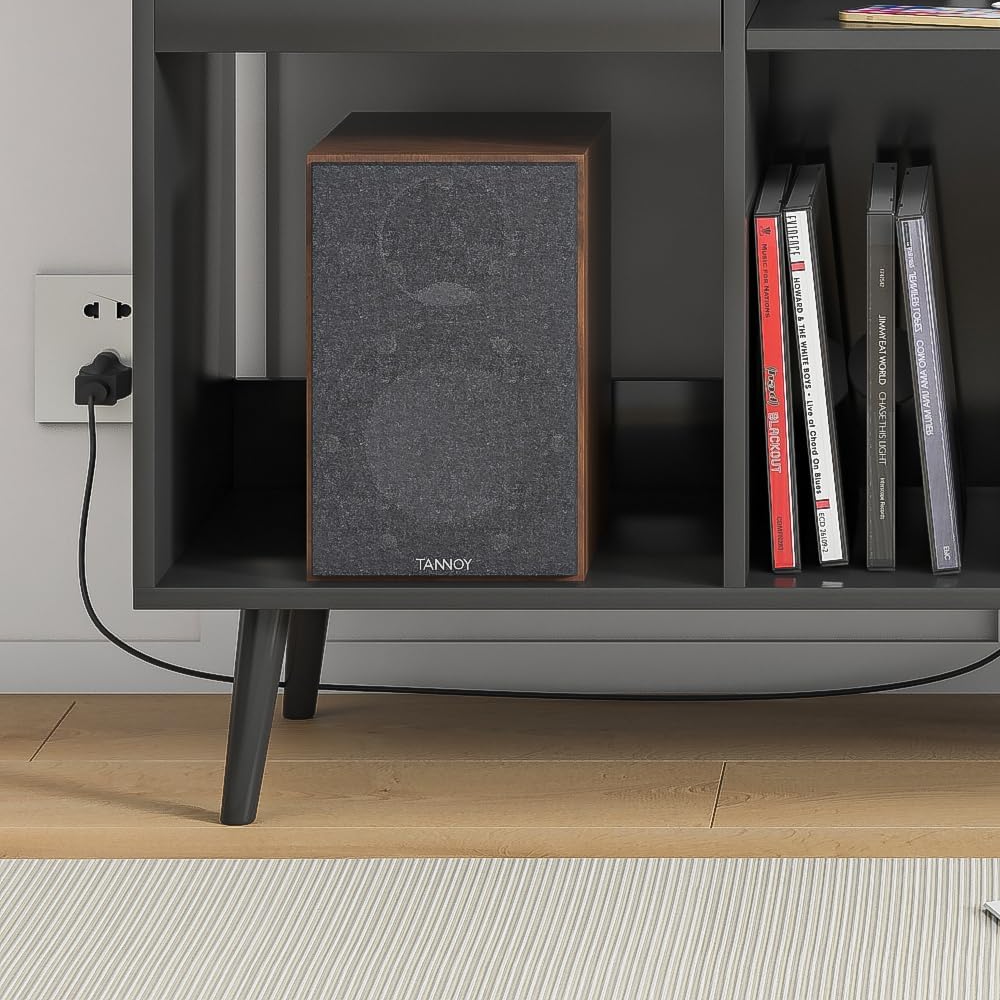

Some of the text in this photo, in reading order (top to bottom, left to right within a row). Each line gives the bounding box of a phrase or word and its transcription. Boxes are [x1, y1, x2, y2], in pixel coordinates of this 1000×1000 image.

[793, 278, 803, 313] HOWARD
[800, 341, 809, 365] WHITE
[878, 314, 887, 385] JIMMY EAT WORLD
[803, 368, 811, 389] BOYS
[806, 400, 814, 416] Live
[808, 419, 816, 427] at
[878, 392, 887, 465] CHASE THIS LIGHT
[767, 412, 781, 473] BLACKOUT
[809, 431, 819, 455] Chord
[813, 458, 820, 470] On
[814, 473, 822, 494] Blues
[818, 512, 826, 527] ECD
[416, 558, 472, 571] TANNOY
